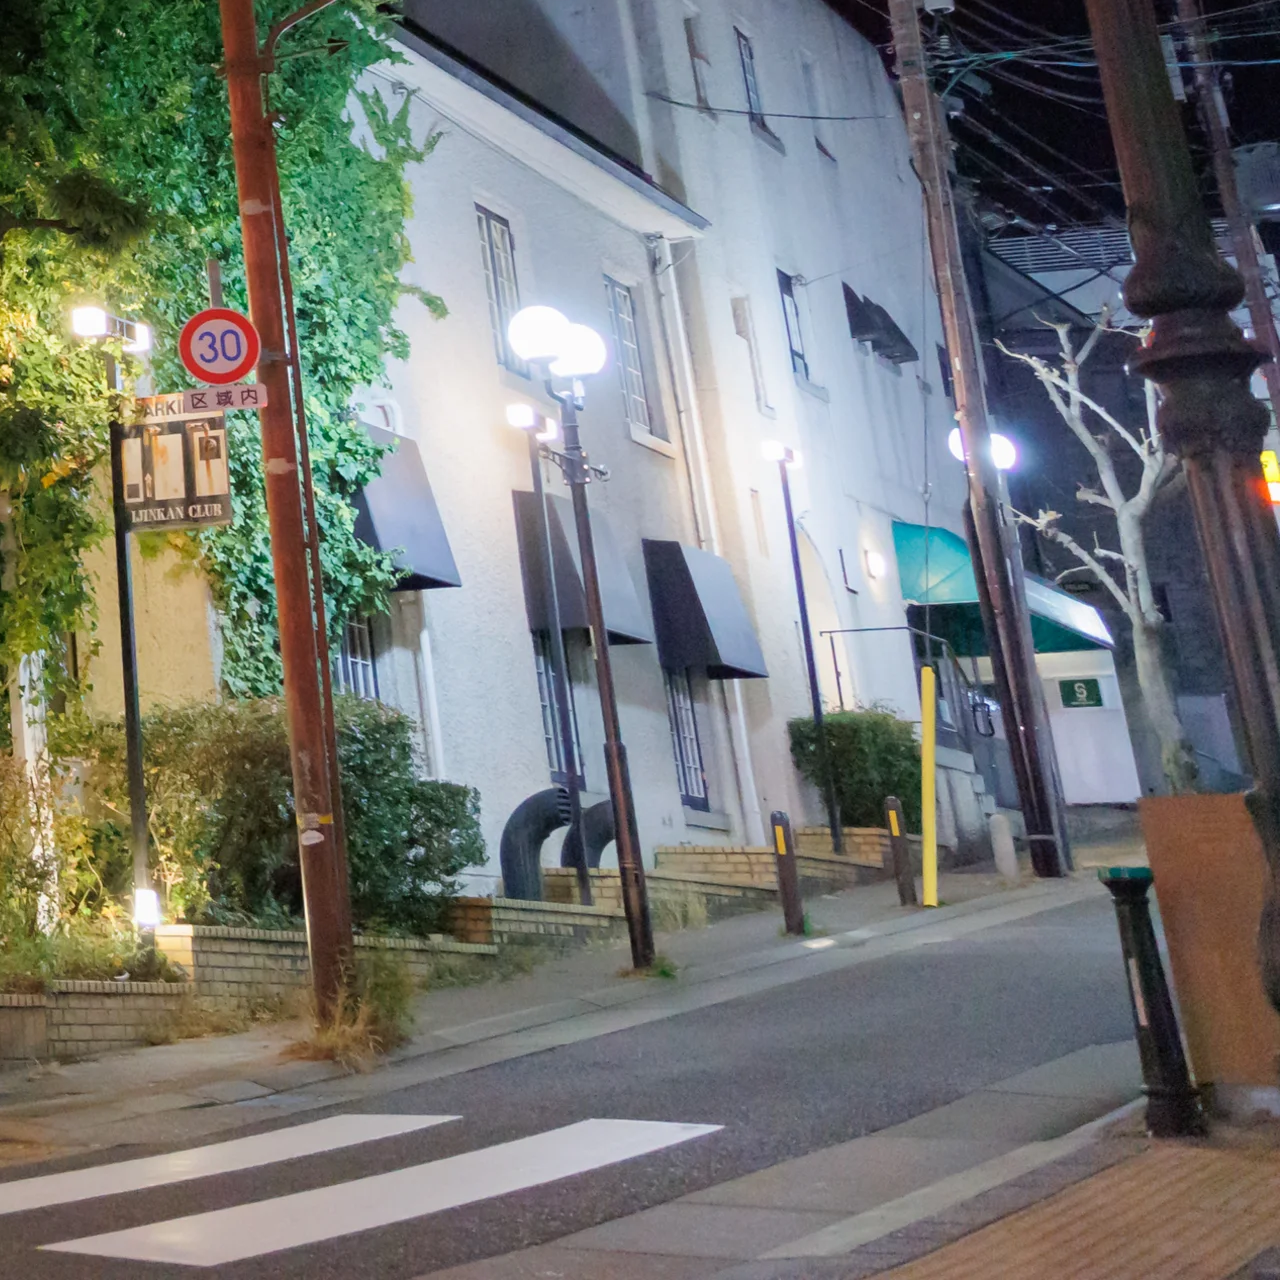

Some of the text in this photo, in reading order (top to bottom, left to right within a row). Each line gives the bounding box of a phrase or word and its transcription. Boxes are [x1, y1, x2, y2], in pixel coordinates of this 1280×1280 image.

[198, 329, 241, 363] 30
[191, 389, 258, 409] 区域内
[131, 503, 222, 522] IJINKAN CLUB
